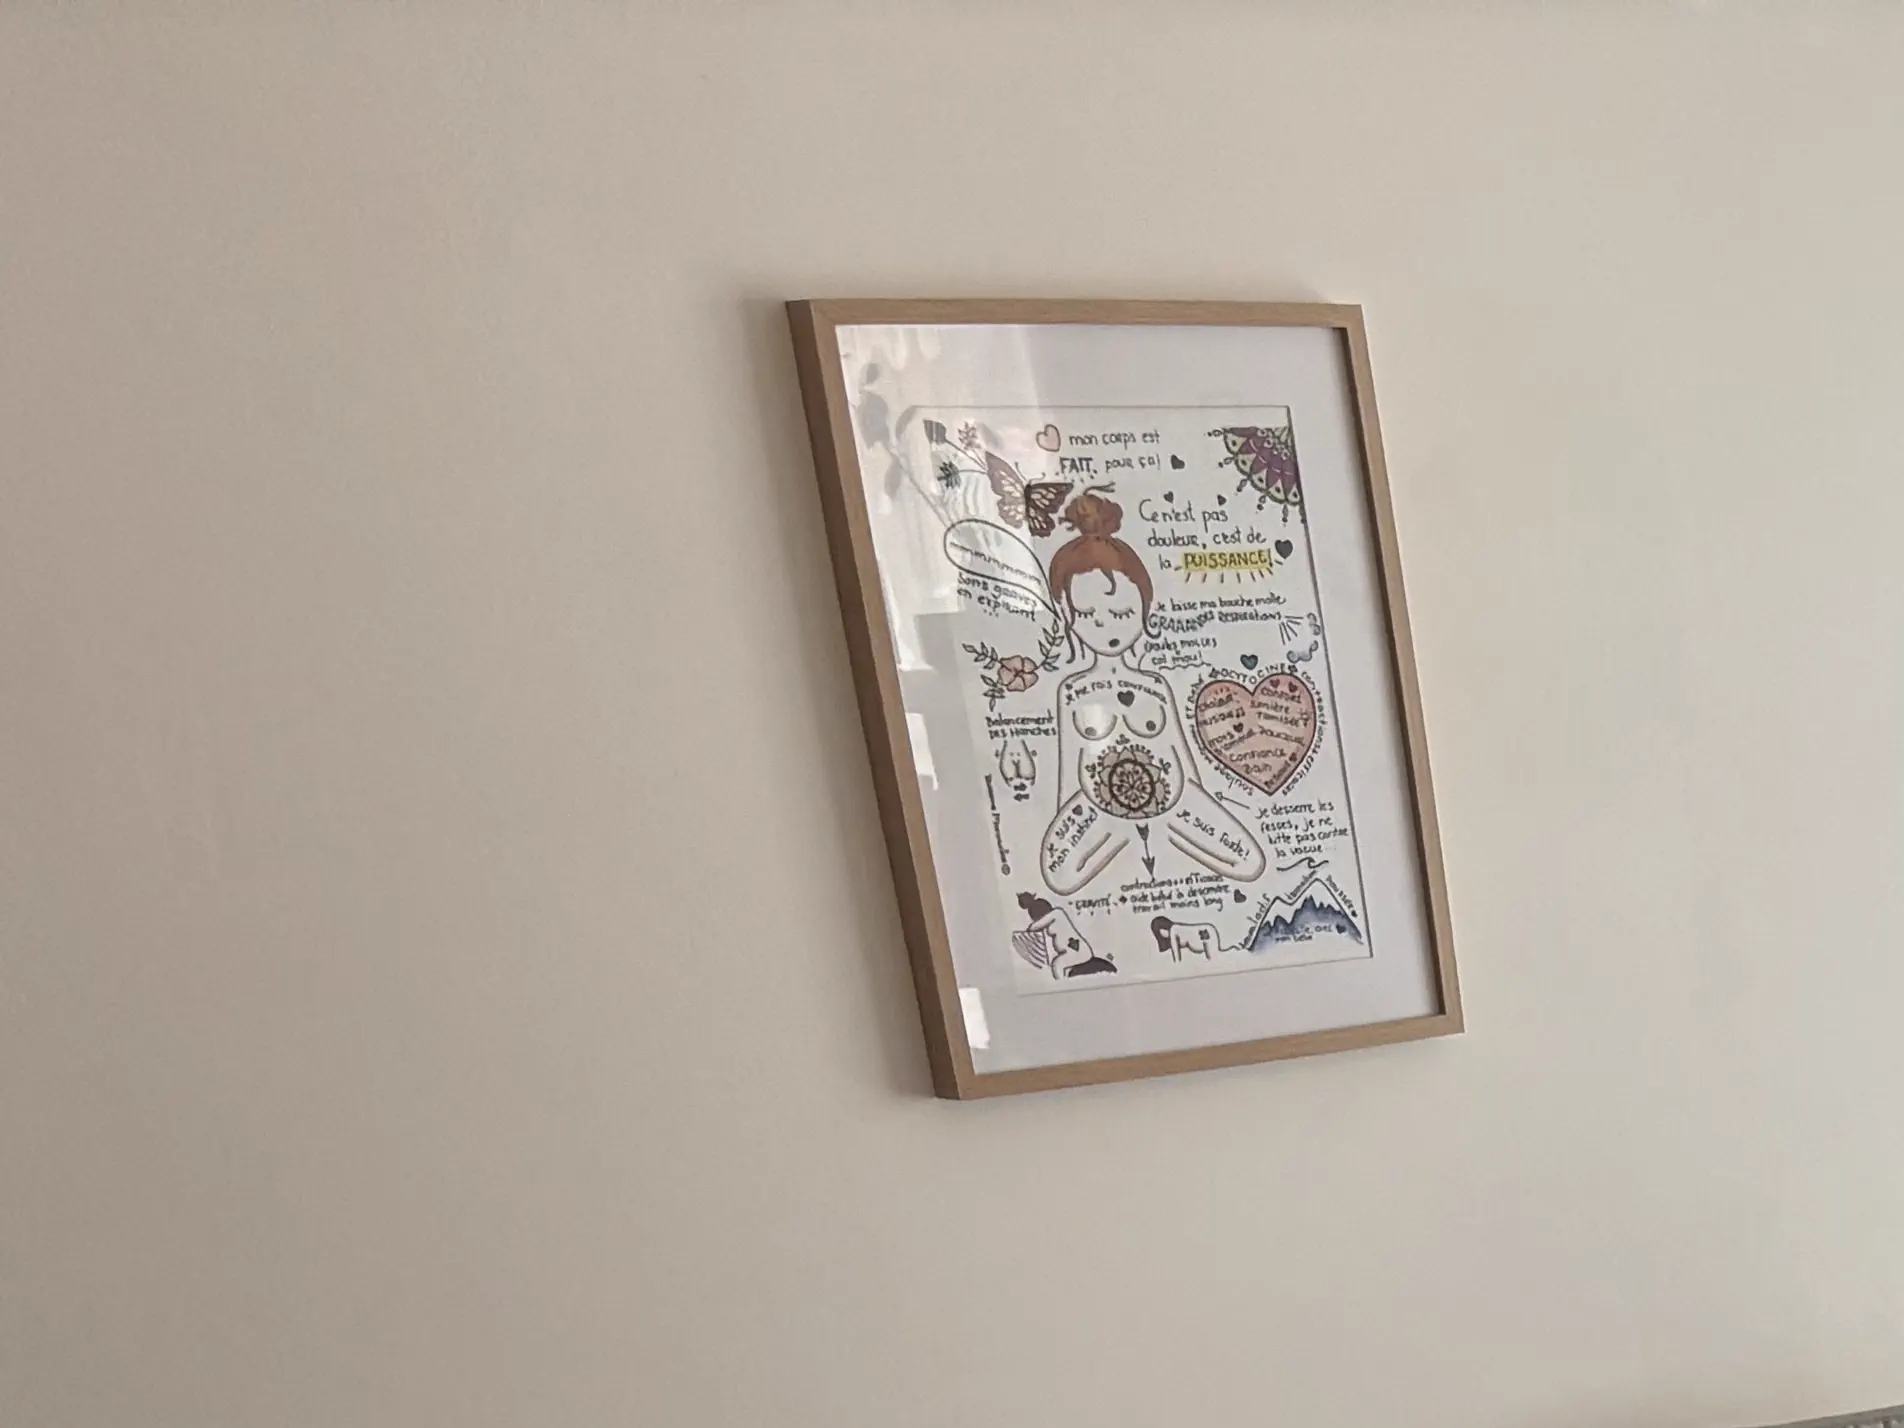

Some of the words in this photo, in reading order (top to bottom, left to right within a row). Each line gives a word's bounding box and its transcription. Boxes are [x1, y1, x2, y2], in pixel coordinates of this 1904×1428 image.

[1069, 431, 1099, 446] mon
[1103, 430, 1136, 451] corps
[1141, 429, 1160, 444] est
[1105, 457, 1134, 472] pour
[1202, 509, 1229, 533] pas
[1247, 526, 1267, 544] de
[1159, 553, 1172, 570] la
[1193, 817, 1216, 838] suis
